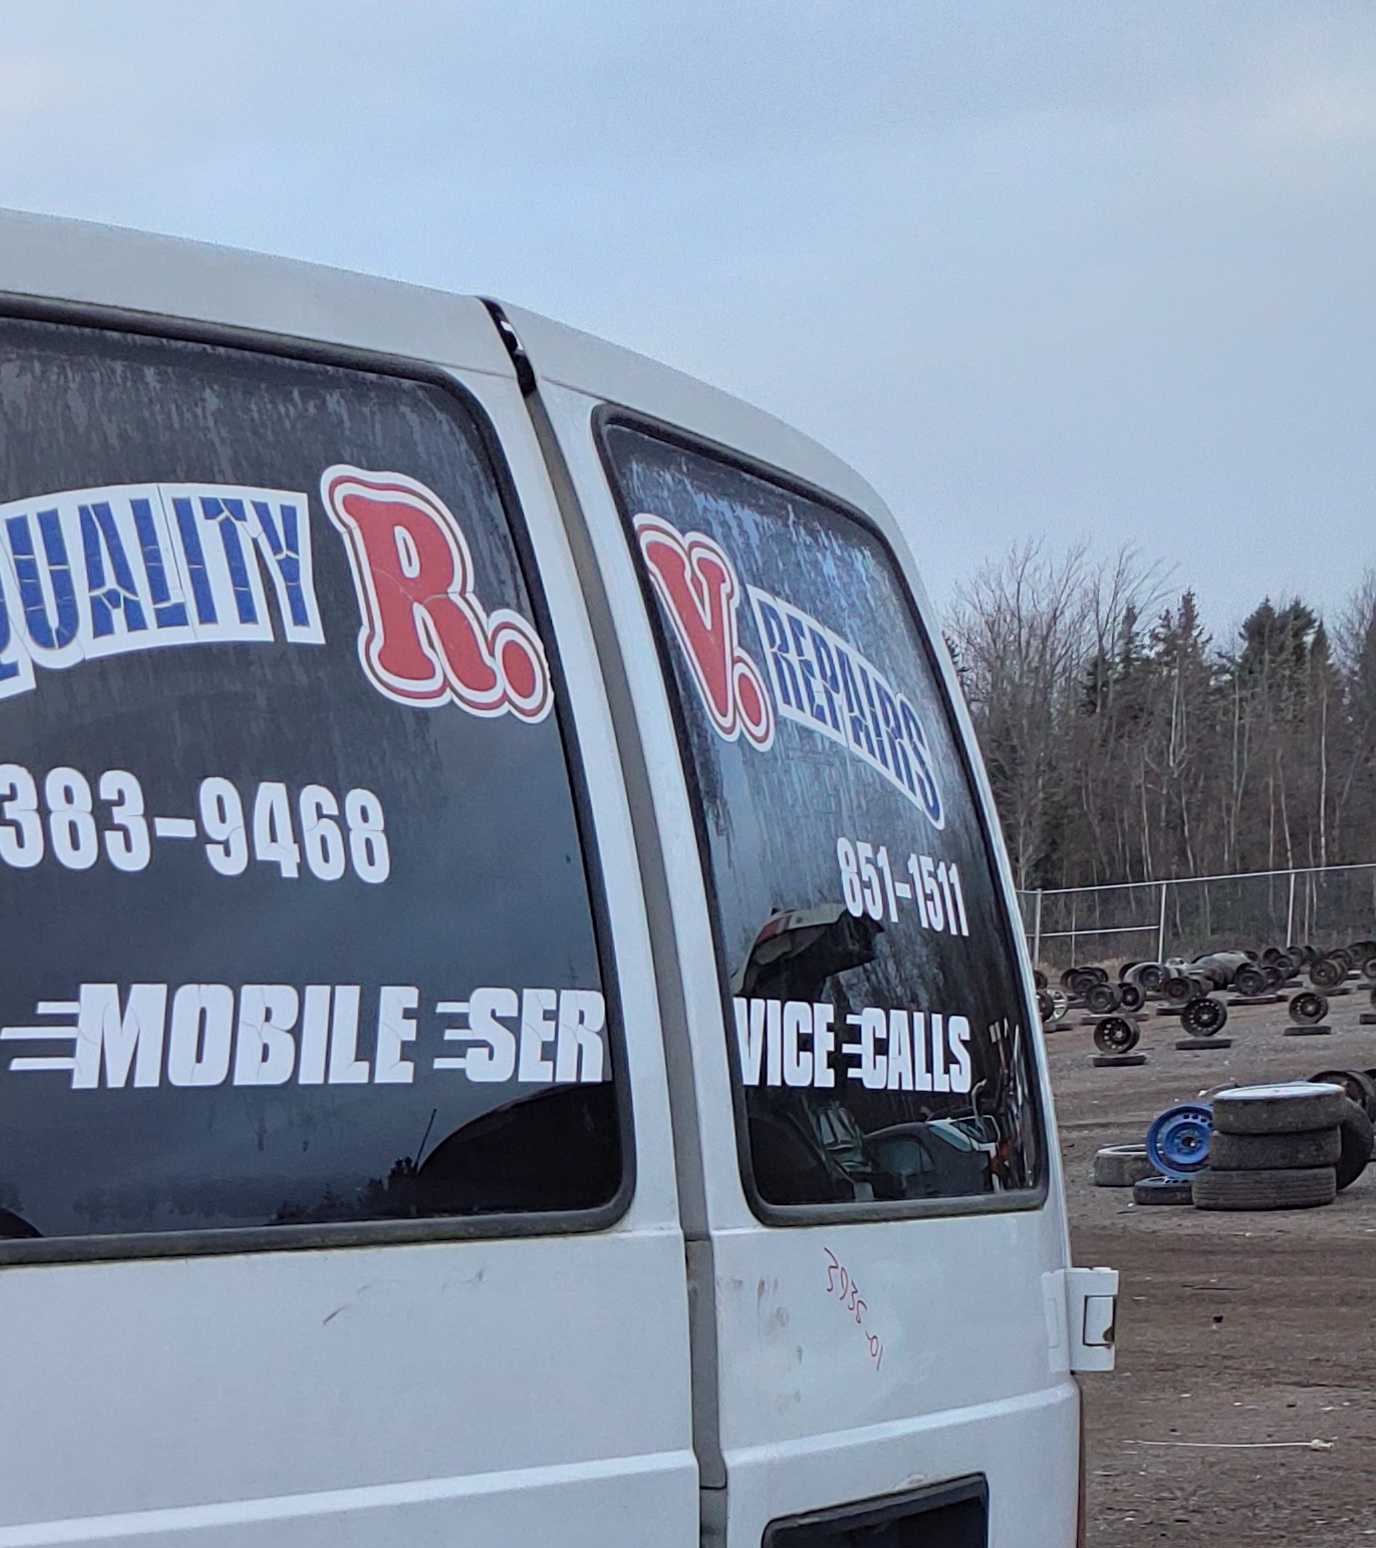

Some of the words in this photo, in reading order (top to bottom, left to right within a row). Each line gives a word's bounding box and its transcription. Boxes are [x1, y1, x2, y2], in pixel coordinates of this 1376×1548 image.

[320, 464, 554, 724] R.
[632, 513, 776, 752] V.
[747, 584, 945, 830] REPAIRS
[836, 837, 970, 937] 851-1511
[71, 983, 420, 1089] MOBILE
[465, 987, 606, 1083] SER
[733, 997, 835, 1089] VICE
[860, 1006, 972, 1094] CALLS
